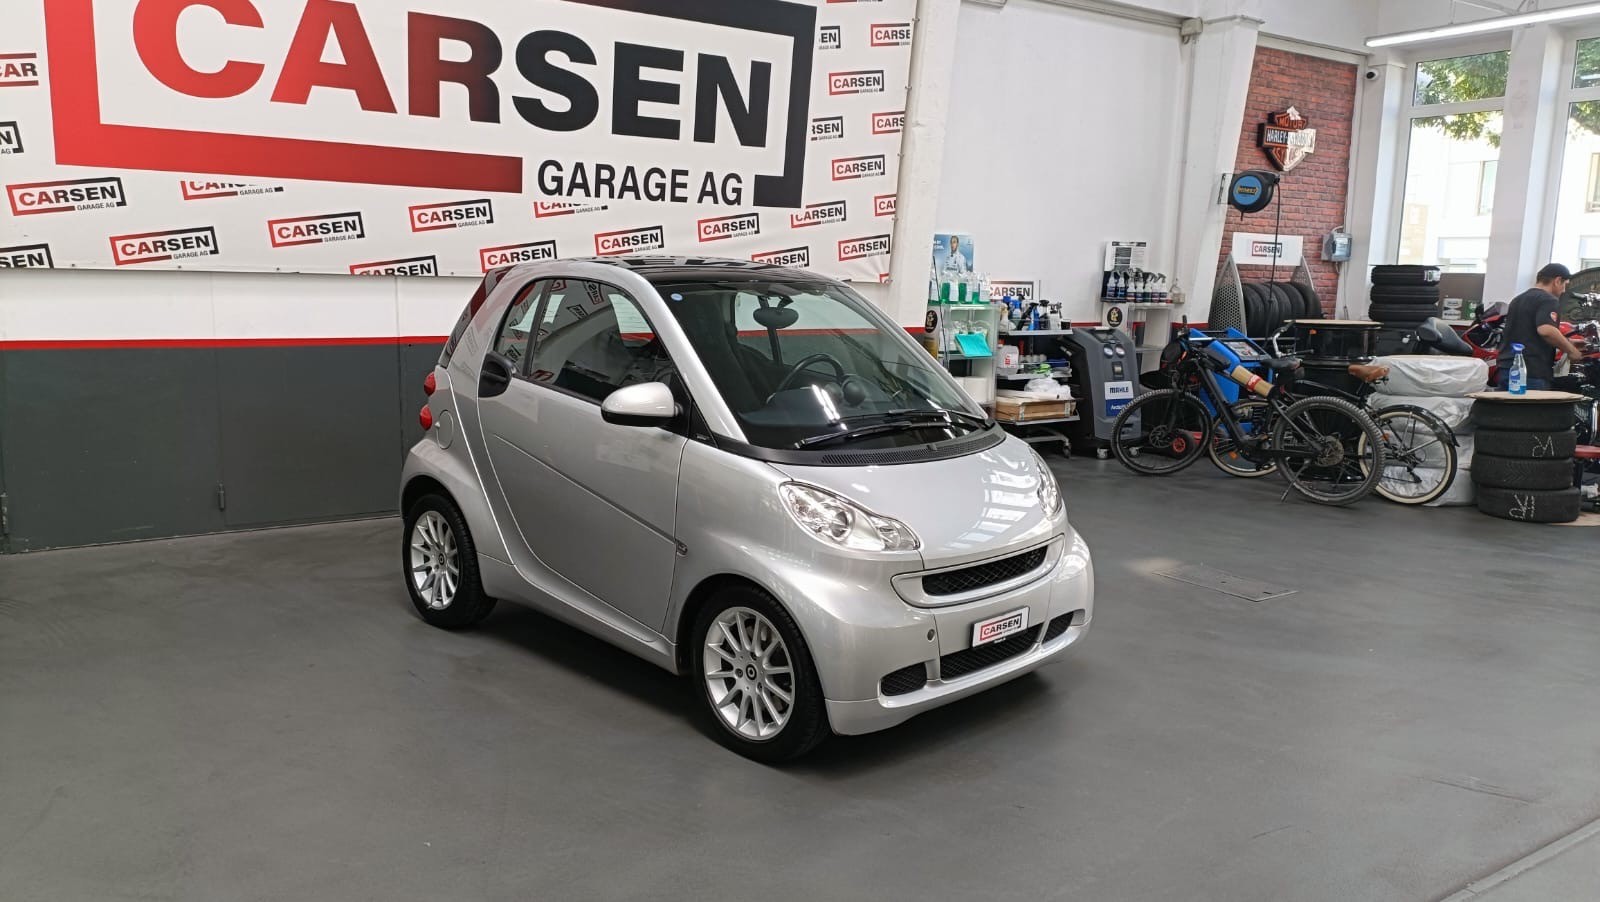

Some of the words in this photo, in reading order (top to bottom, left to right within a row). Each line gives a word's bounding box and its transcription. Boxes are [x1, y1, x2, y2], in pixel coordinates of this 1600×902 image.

[0, 63, 38, 78] AR
[133, 0, 771, 148] CARSEN
[833, 76, 881, 89] CARSEN
[836, 161, 882, 174] CARSEN
[538, 159, 688, 203] GARAGE
[697, 172, 743, 206] AG
[19, 185, 117, 206] CARSEN
[240, 188, 263, 196] GARAGE
[77, 203, 104, 211] GARAGE
[417, 205, 487, 224] CARSEN
[277, 219, 357, 239] CARSEN
[703, 218, 756, 236] CARSEN
[121, 234, 210, 256] CARSEN
[601, 232, 659, 250] CARSEN
[843, 239, 887, 255] CARSEN
[1254, 245, 1281, 254] CARSEN
[173, 252, 199, 260] GARAGE
[487, 247, 552, 266] CARSEN
[983, 618, 1020, 636] CARSEN
